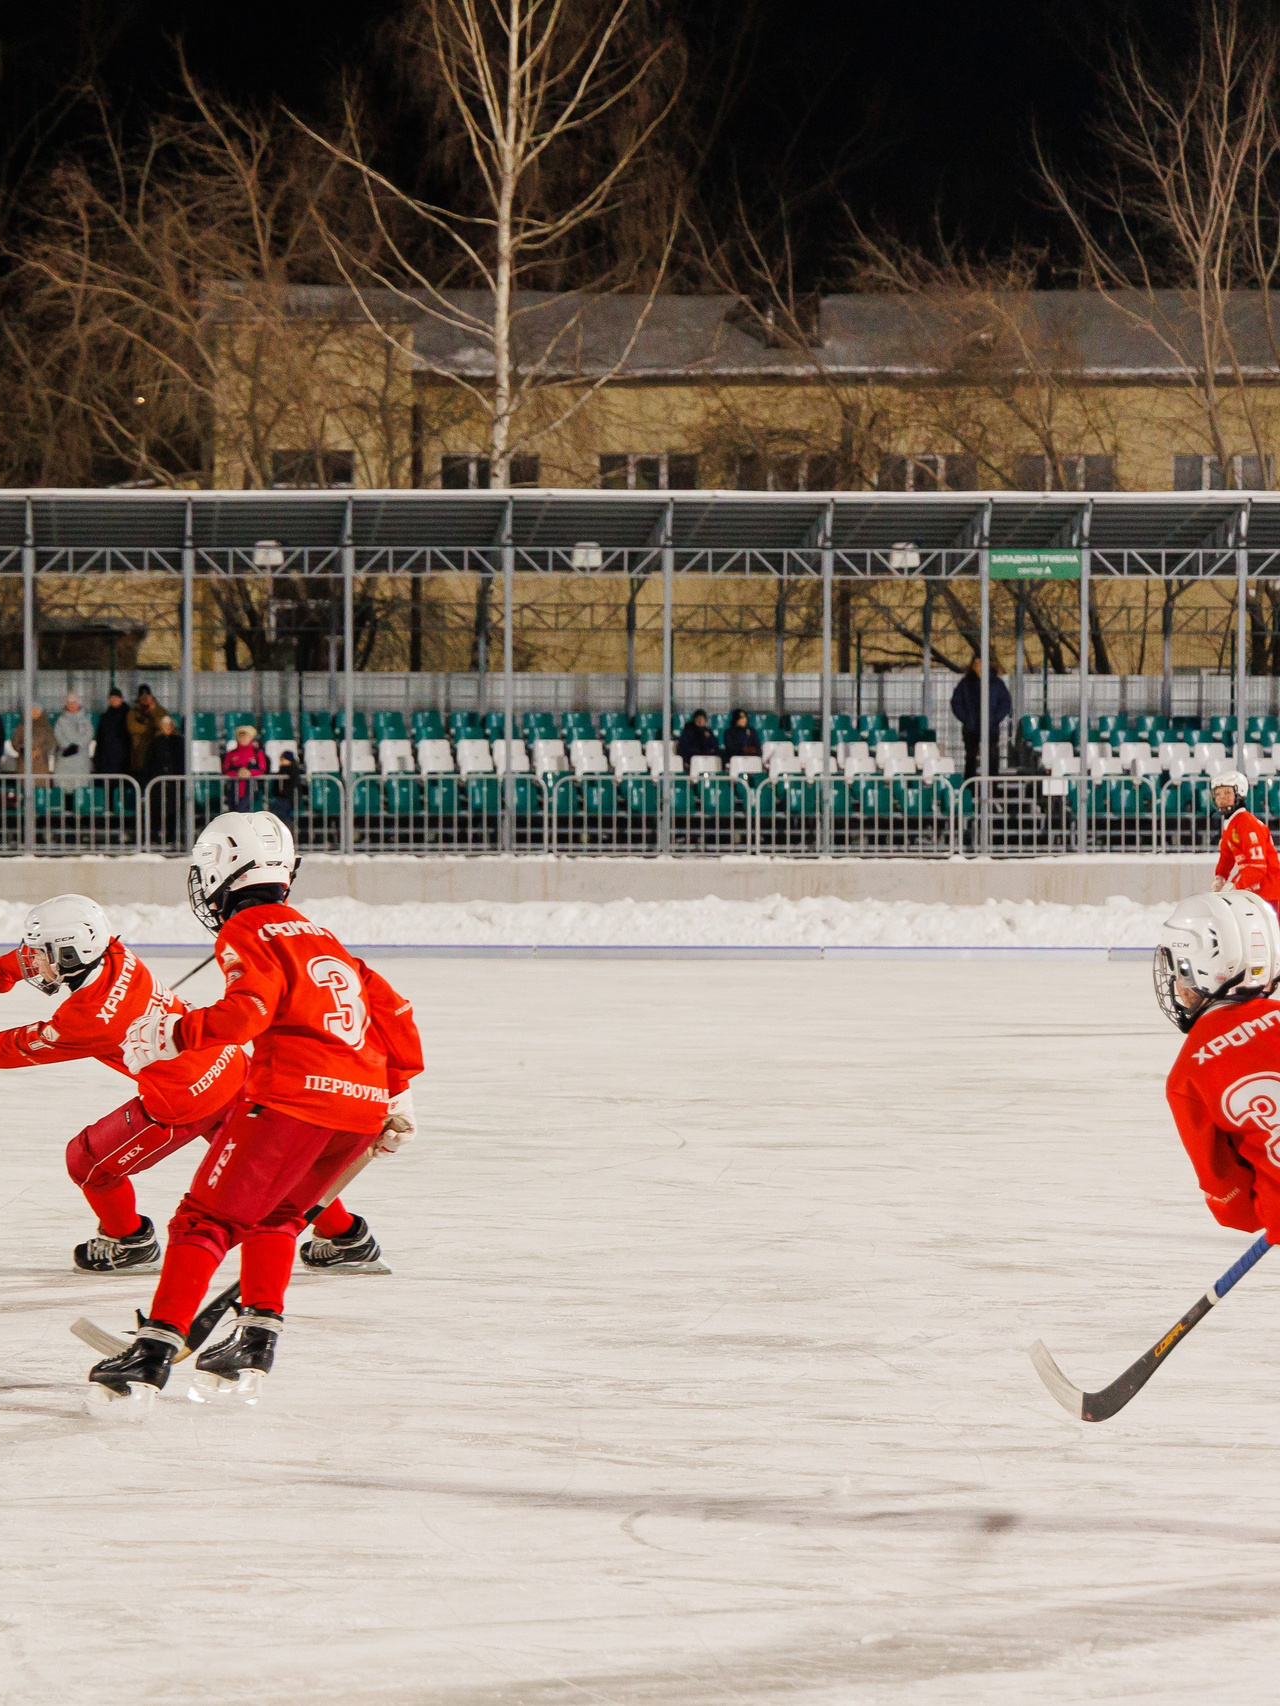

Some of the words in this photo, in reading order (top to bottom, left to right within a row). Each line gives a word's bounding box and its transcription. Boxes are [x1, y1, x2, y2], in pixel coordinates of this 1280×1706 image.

[95, 947, 138, 1025] ХРОМПИ
[306, 955, 371, 1051] 3
[1191, 1010, 1280, 1065] ХРОМП
[188, 1044, 238, 1097] ПЕРВОУРА
[117, 1143, 144, 1166] STEX
[207, 1138, 237, 1189] STEX
